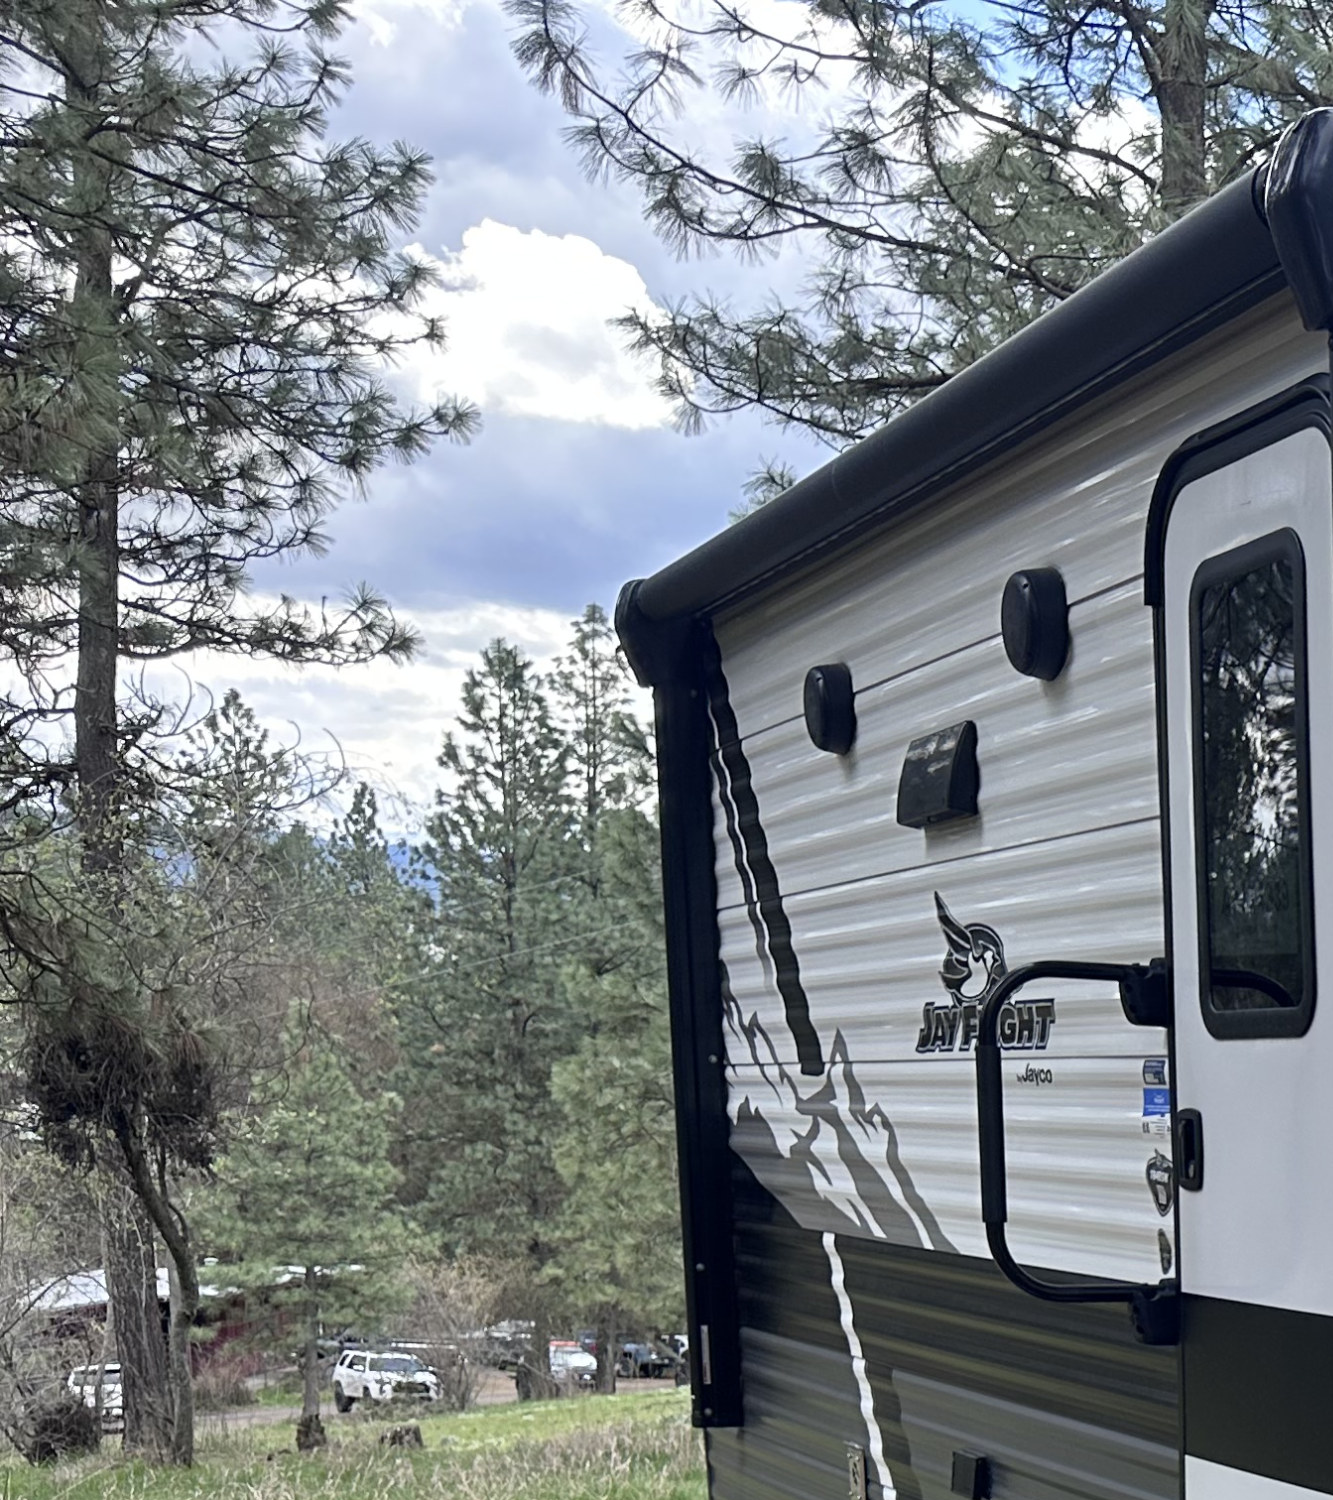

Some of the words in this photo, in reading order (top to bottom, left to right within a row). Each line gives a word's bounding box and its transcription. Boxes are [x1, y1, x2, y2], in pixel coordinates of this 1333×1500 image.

[916, 1002, 961, 1053] JAY
[959, 998, 1056, 1051] FGHT
[1022, 1063, 1053, 1086] Jayco
